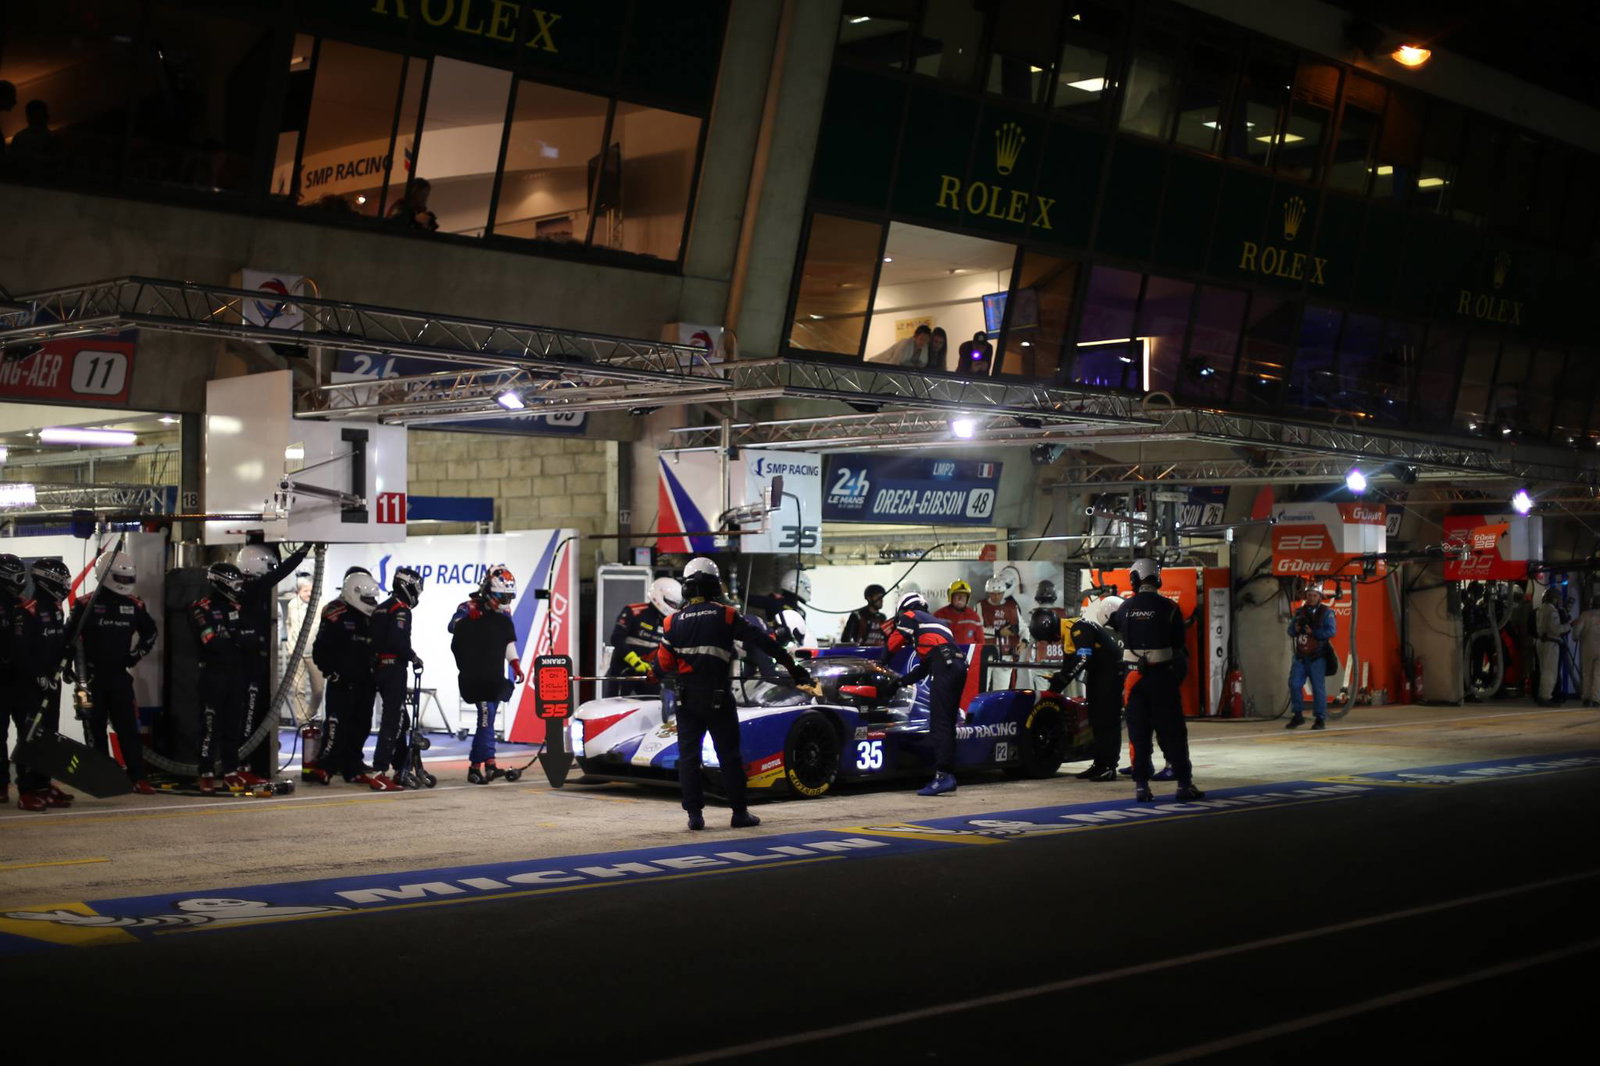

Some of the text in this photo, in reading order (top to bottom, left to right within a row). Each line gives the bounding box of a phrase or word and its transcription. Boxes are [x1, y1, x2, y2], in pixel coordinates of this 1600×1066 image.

[305, 166, 333, 188] SMP
[936, 175, 1056, 230] ROLEX
[1239, 241, 1328, 287] ROLEX
[1457, 289, 1526, 327] ROLEX
[85, 357, 116, 389] 11
[766, 463, 819, 476] SMP RACING
[932, 462, 955, 476] LMP2
[831, 467, 870, 496] 24h
[183, 493, 198, 506] 18
[379, 494, 401, 523] 11
[873, 489, 990, 515] ORECA-GIBSON 48
[621, 512, 631, 522] 17
[1205, 504, 1222, 525] 26
[779, 526, 818, 548] 35
[1278, 535, 1325, 550] 26
[1474, 541, 1495, 549] 26
[541, 703, 569, 718] 35
[975, 721, 1018, 738] RACING
[856, 740, 884, 770] 35
[997, 745, 1007, 760] P2
[1059, 784, 1375, 823] MICHELIN
[334, 837, 891, 904] MICHELIN
